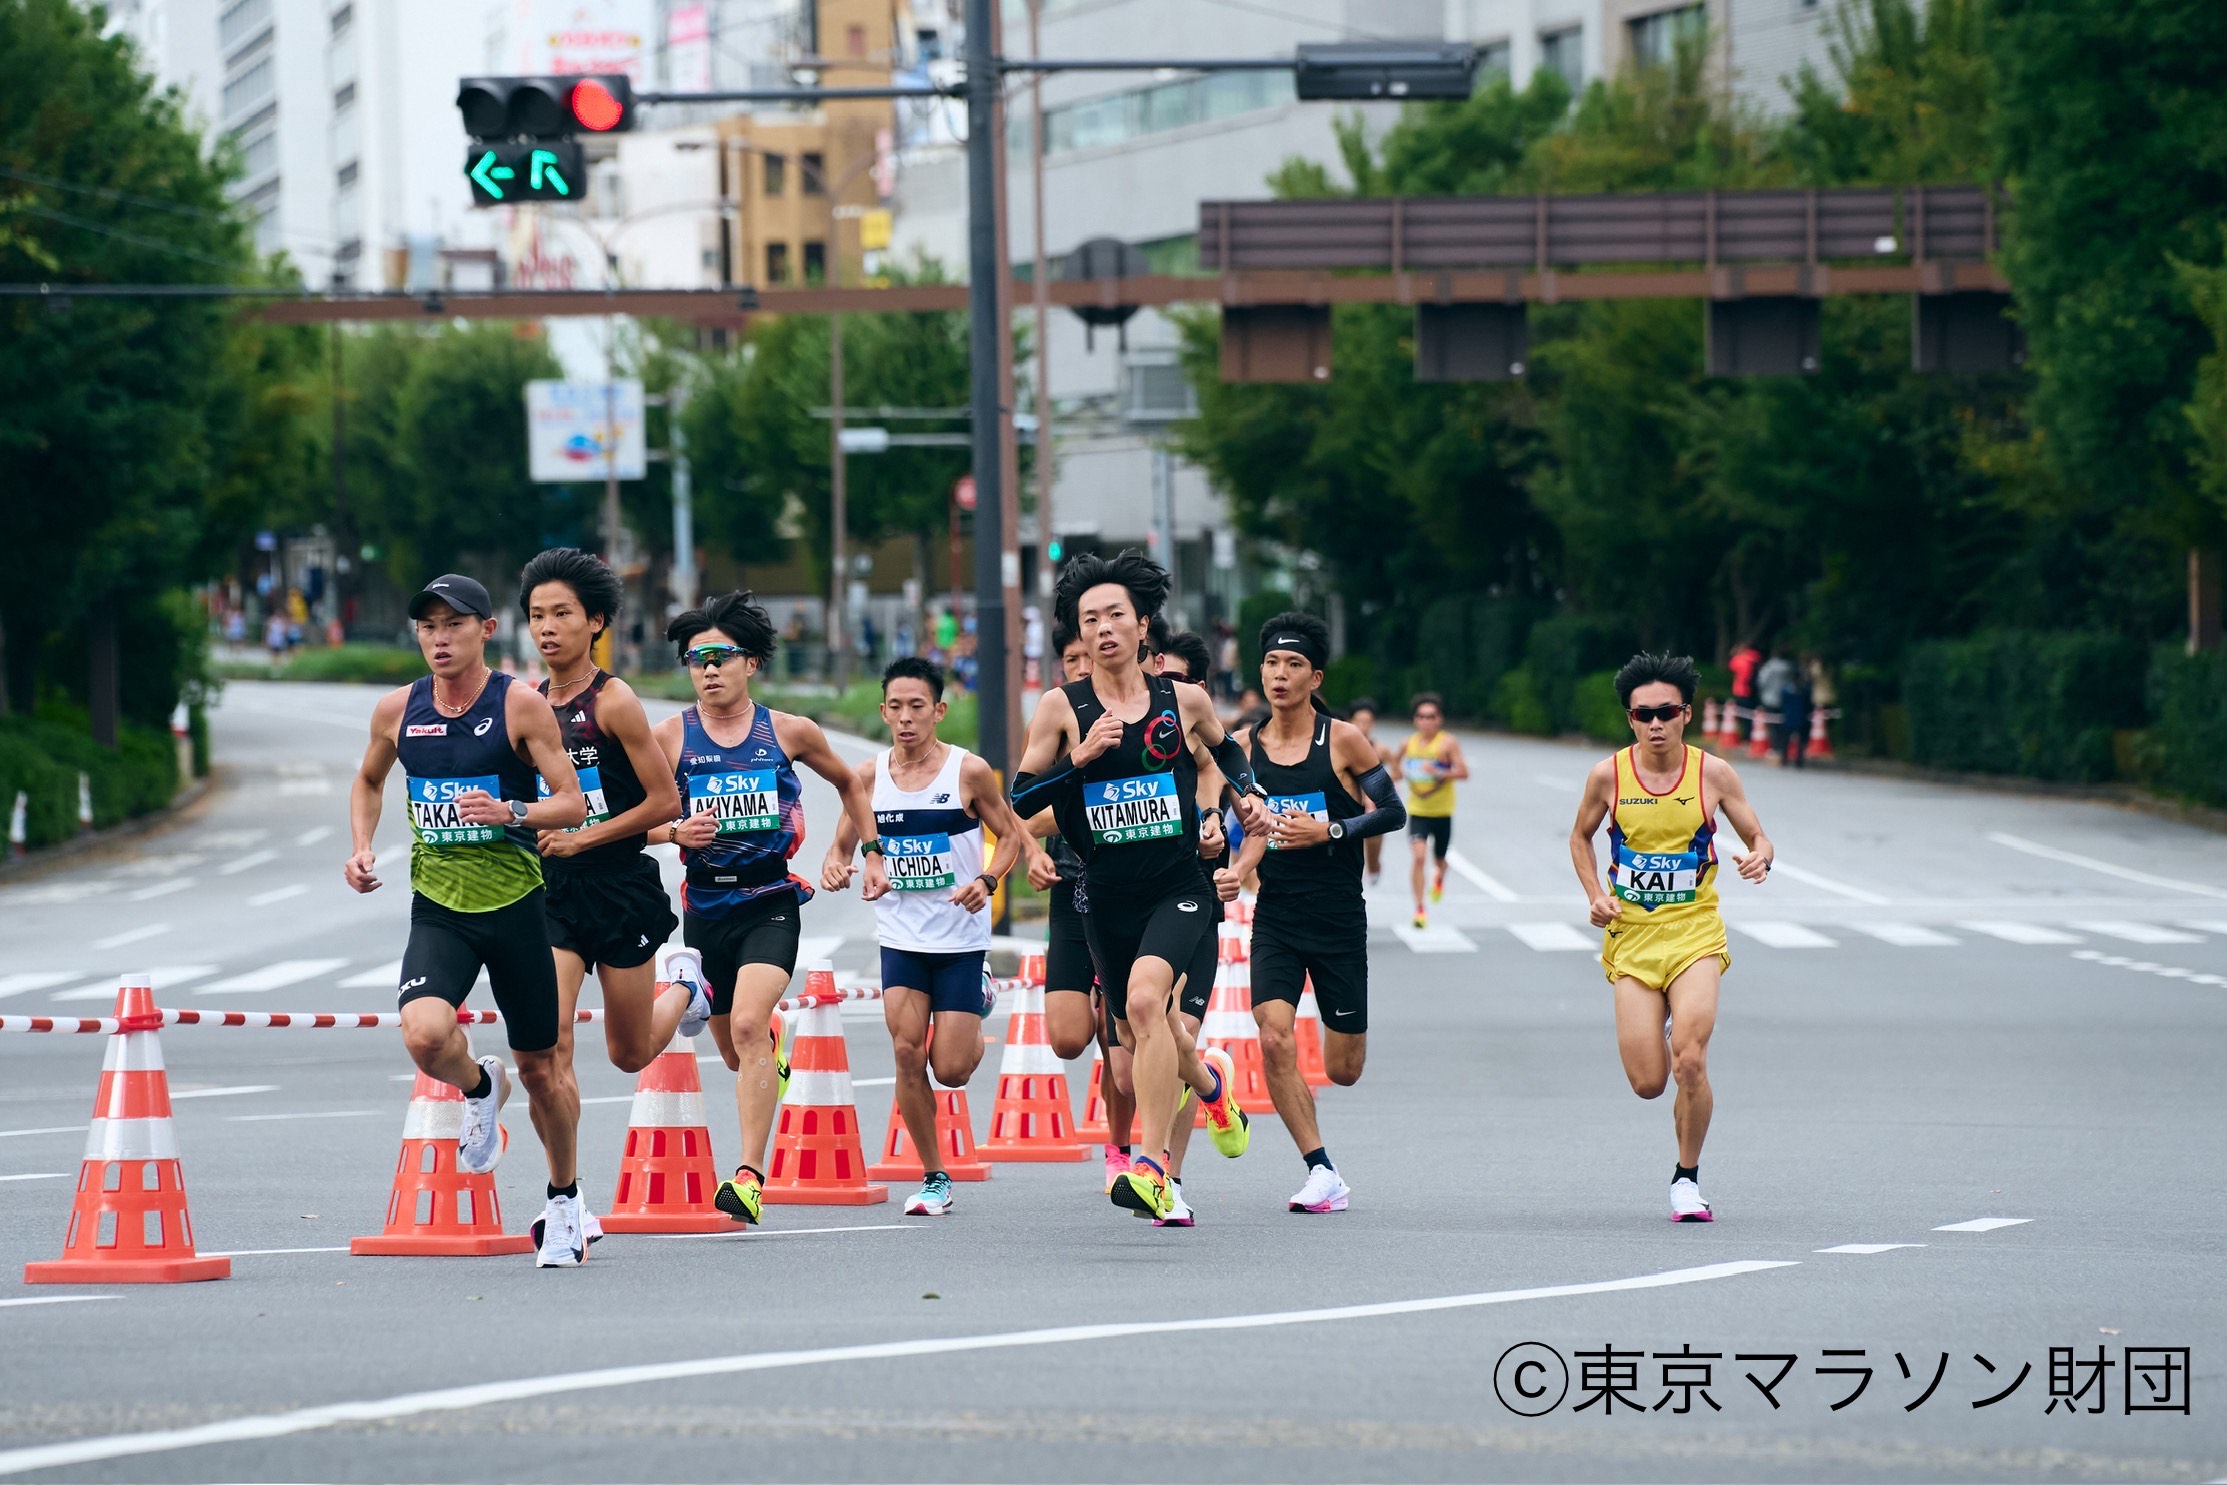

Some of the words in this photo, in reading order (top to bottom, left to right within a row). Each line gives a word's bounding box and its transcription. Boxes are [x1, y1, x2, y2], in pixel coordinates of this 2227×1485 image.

[410, 726, 444, 734] Yakult
[725, 775, 760, 792] Sky
[1122, 780, 1159, 799] Sky
[695, 793, 769, 818] AKIYAMA
[1090, 797, 1170, 830] KITAMURA
[726, 818, 772, 831] 東京建物
[1125, 823, 1174, 840] 東京建物
[441, 829, 493, 842] 東京建物
[902, 838, 933, 854] Sky
[1649, 856, 1682, 870] Sky
[905, 877, 946, 889] 東京建物
[1630, 870, 1674, 891] KAI
[1643, 892, 1686, 903] 東京建物
